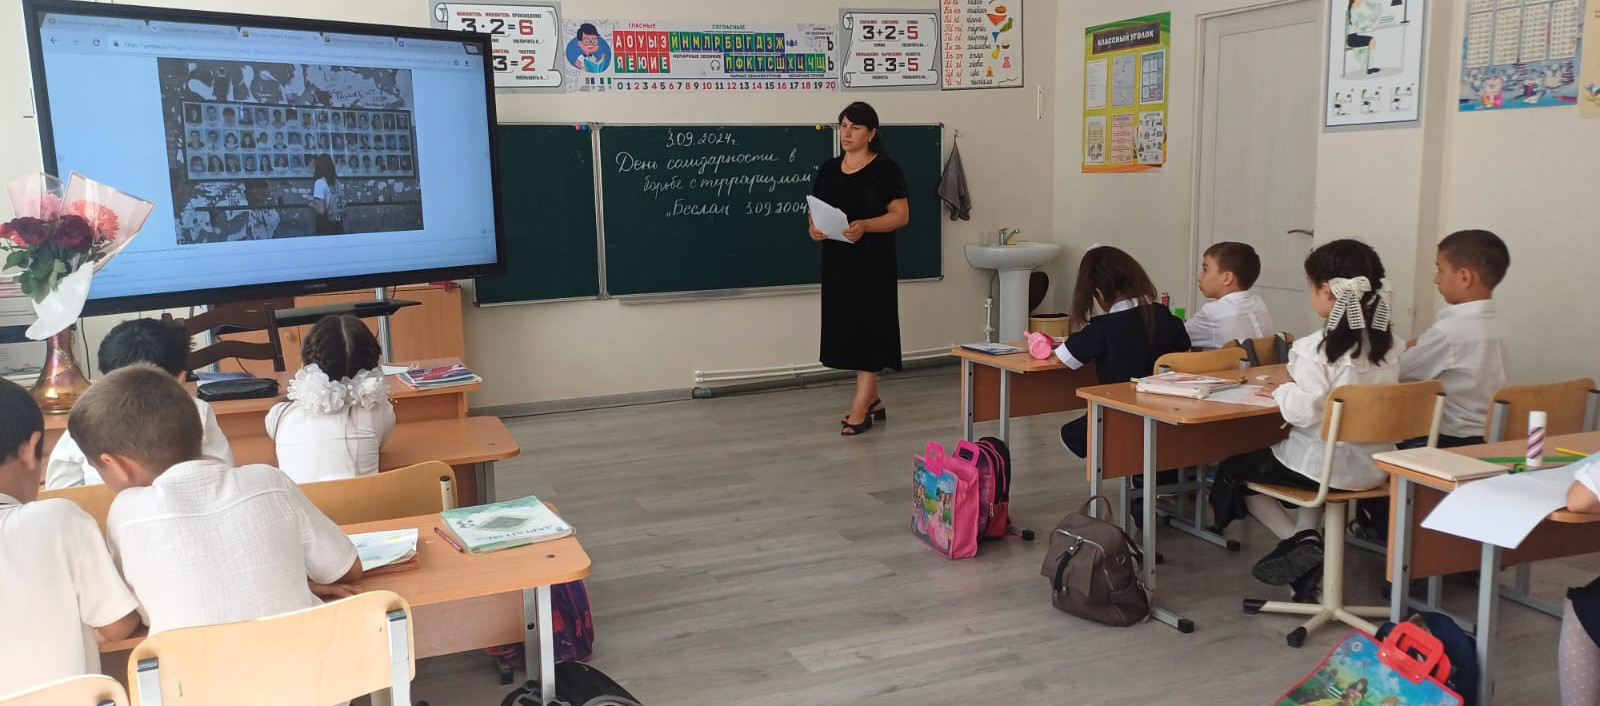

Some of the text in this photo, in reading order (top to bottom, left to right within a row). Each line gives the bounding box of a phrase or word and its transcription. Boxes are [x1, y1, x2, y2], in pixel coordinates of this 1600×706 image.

[1098, 30, 1154, 46] КЛАССНЫЙ УГОЛОК
[617, 82, 836, 90] 0 1 2 3 4 5 6 7 8 9 10 11 12 13 14 15 16 17 18 19 20
[616, 148, 798, 174] День солидарности в
[644, 175, 683, 200] борьбе
[690, 178, 696, 188] с
